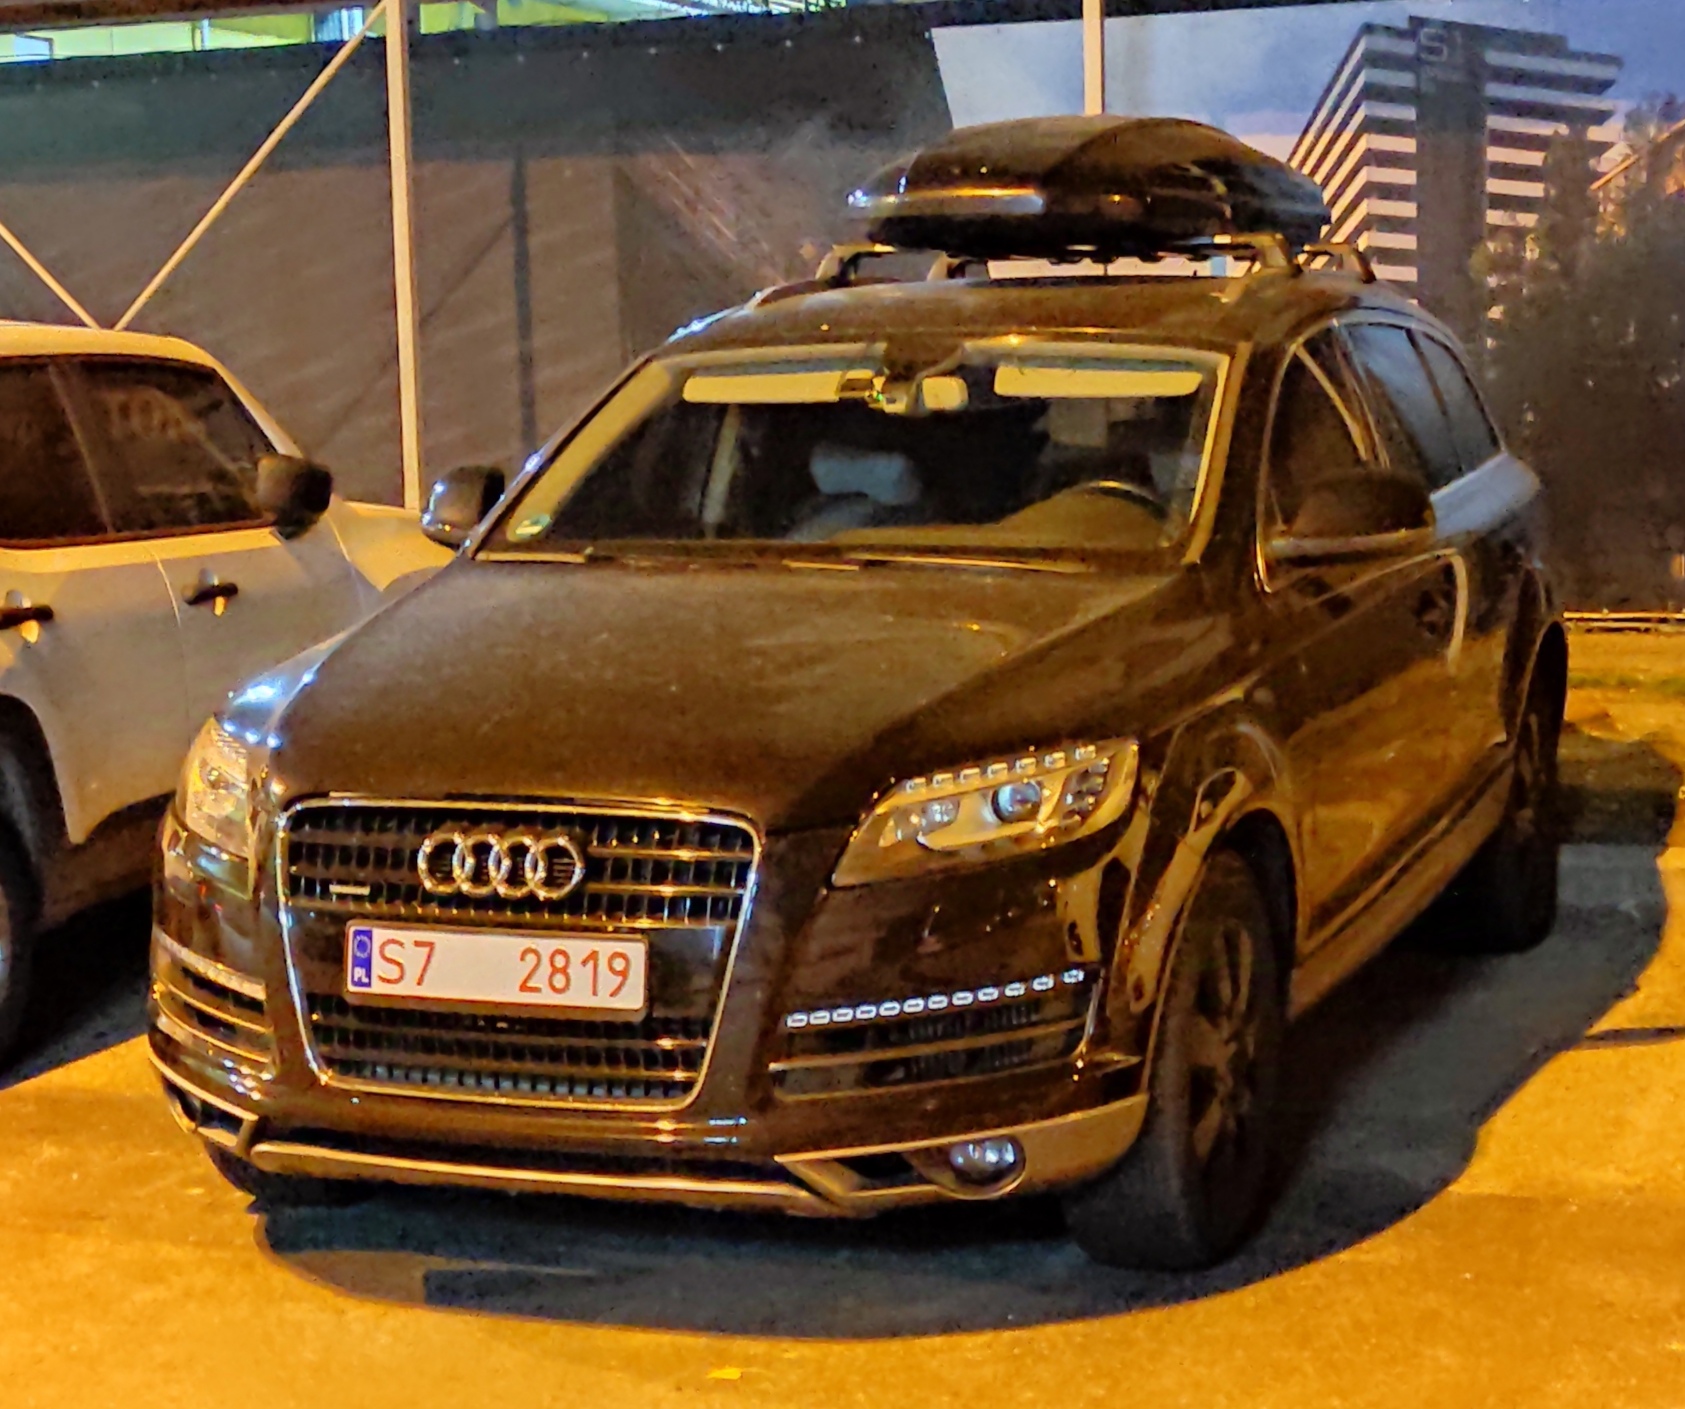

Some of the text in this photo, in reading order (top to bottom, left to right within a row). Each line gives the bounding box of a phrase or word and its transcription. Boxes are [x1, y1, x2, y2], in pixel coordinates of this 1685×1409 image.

[353, 966, 369, 984] PL
[377, 938, 632, 998] S7 2819
